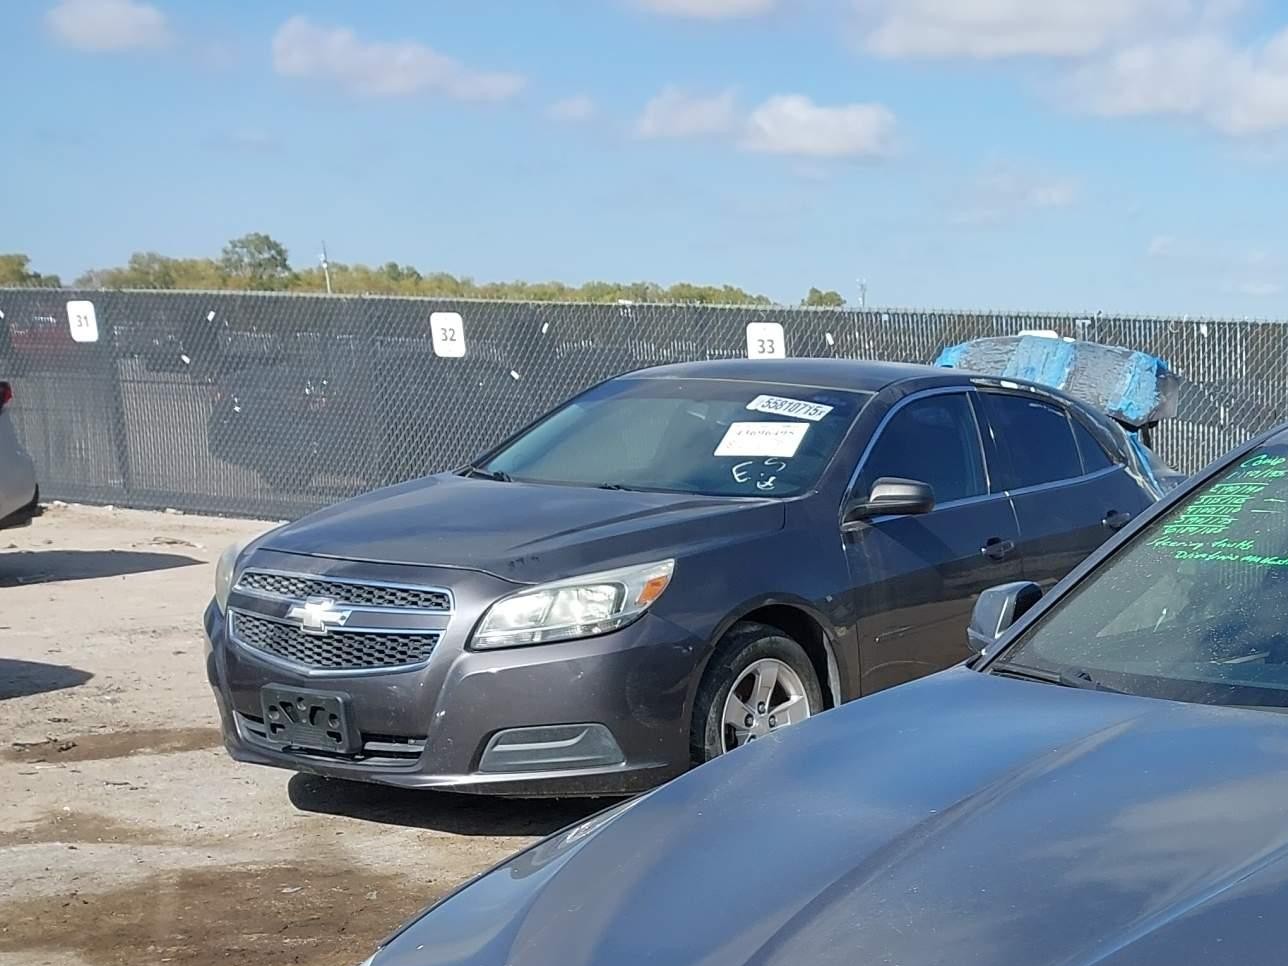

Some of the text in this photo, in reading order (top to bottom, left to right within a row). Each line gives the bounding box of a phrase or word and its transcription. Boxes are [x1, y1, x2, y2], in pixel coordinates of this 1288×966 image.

[76, 314, 89, 328] 31
[440, 327, 457, 342] 32
[757, 338, 775, 354] 33
